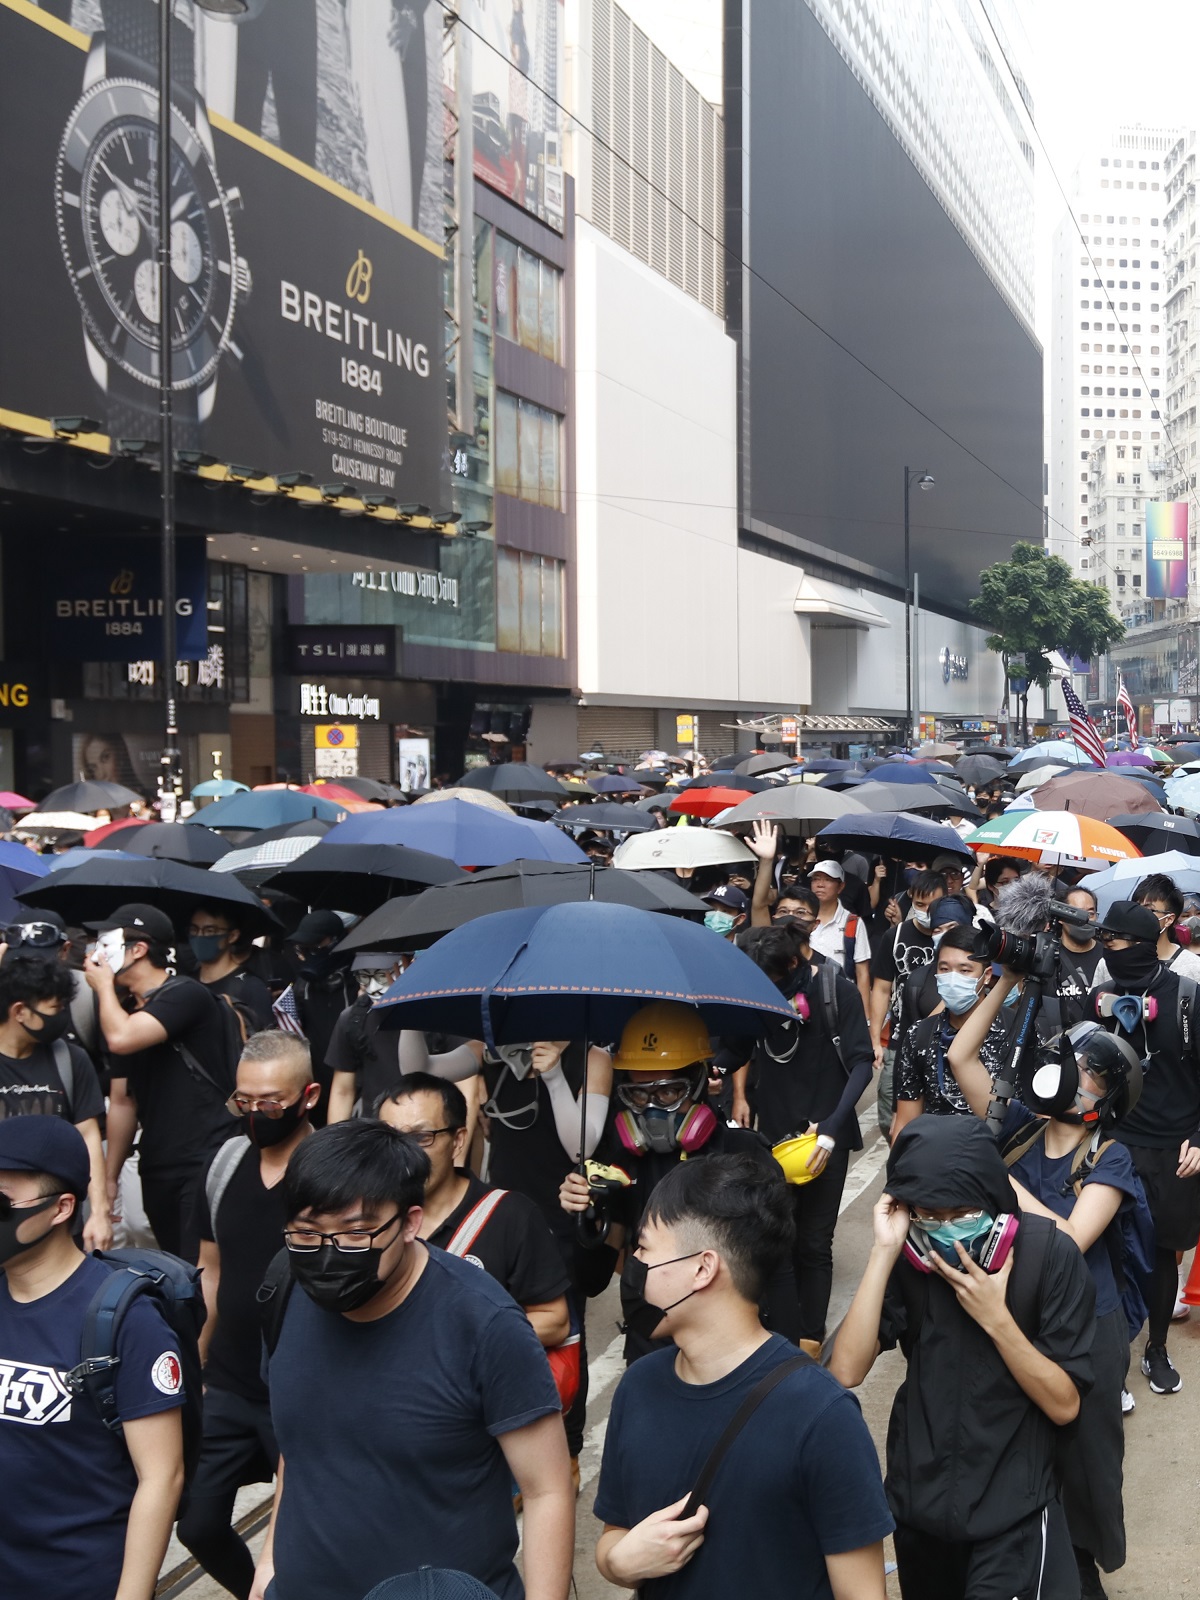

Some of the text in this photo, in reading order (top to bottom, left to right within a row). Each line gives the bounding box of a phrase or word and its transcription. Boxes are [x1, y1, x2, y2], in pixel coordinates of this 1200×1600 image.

[280, 280, 430, 378] BREITLING
[341, 357, 383, 396] 1884
[315, 399, 408, 447] BREITLING BOUTIQUE
[322, 428, 403, 465] 519-521 HENNESSY ROAD
[331, 453, 396, 488] CAUSEWAY BAY
[56, 598, 193, 617] BREITLIG
[106, 622, 143, 635] 1884
[298, 645, 337, 656] TSL
